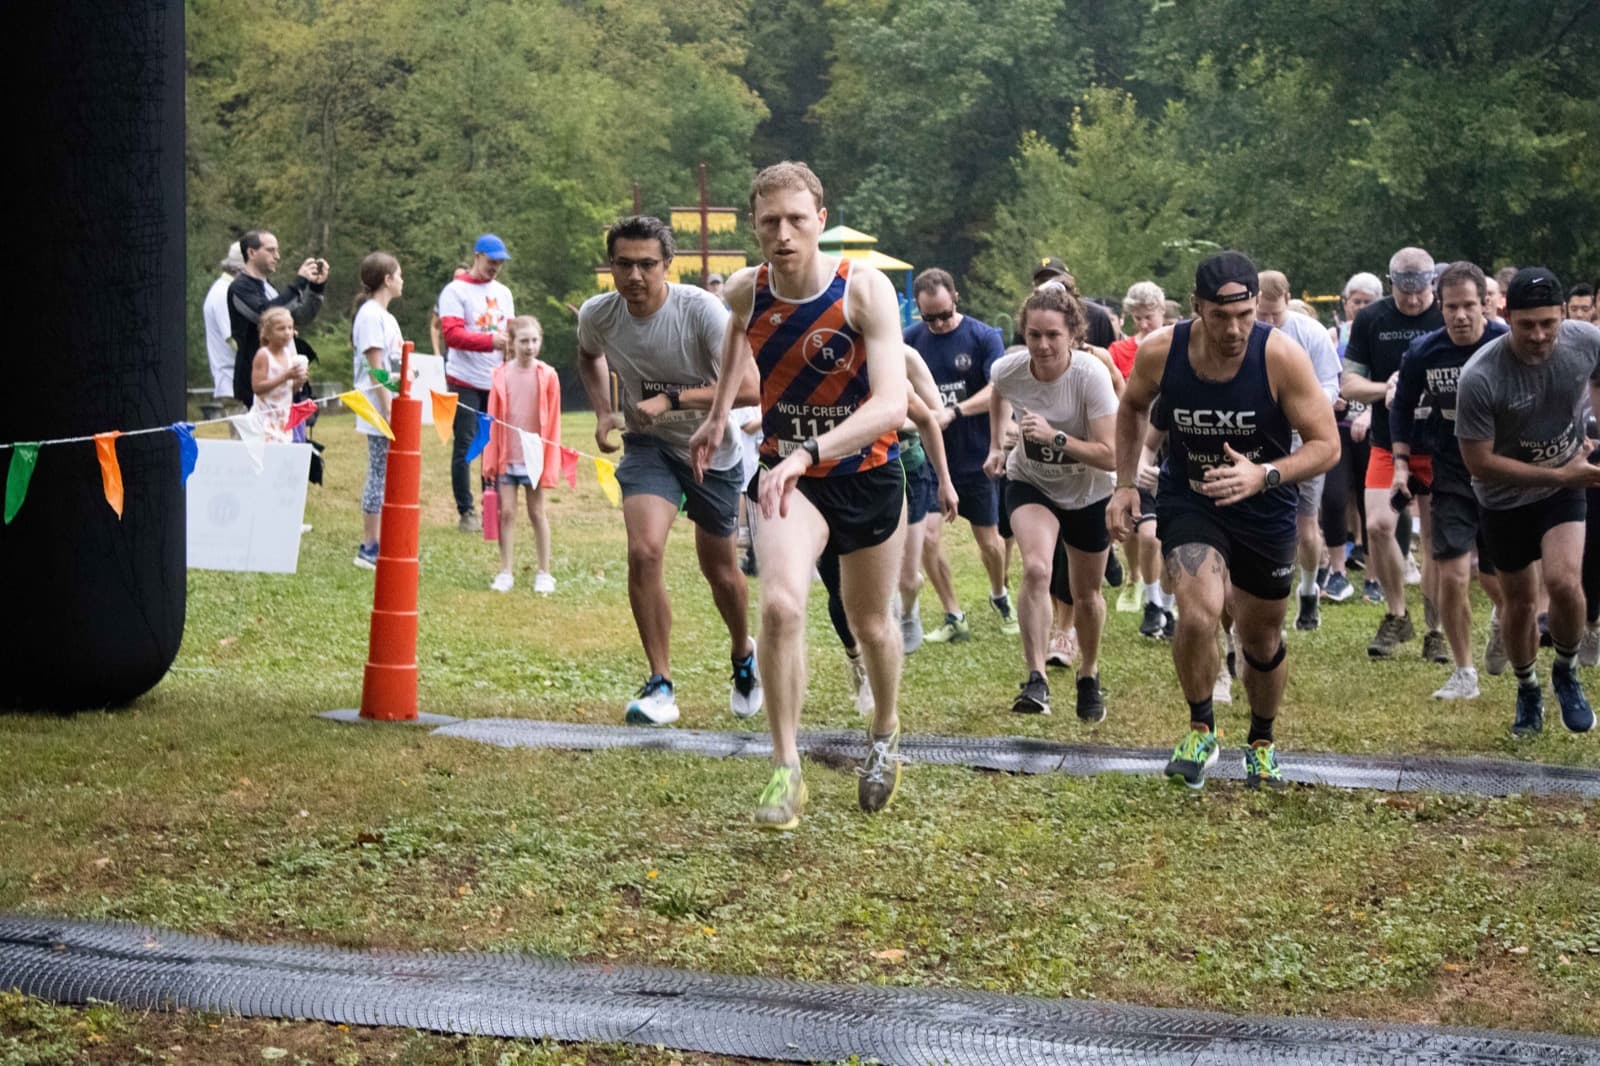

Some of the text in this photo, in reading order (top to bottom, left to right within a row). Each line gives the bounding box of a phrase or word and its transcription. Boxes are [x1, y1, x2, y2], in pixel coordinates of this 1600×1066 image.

[1426, 367, 1461, 380] NOTR
[1439, 385, 1457, 393] WOL
[777, 402, 810, 416] WOLF
[1173, 408, 1256, 429] GCXC
[1177, 426, 1256, 436] ambassador
[1188, 448, 1262, 463] WOLF CEK
[1531, 436, 1569, 461] 205
